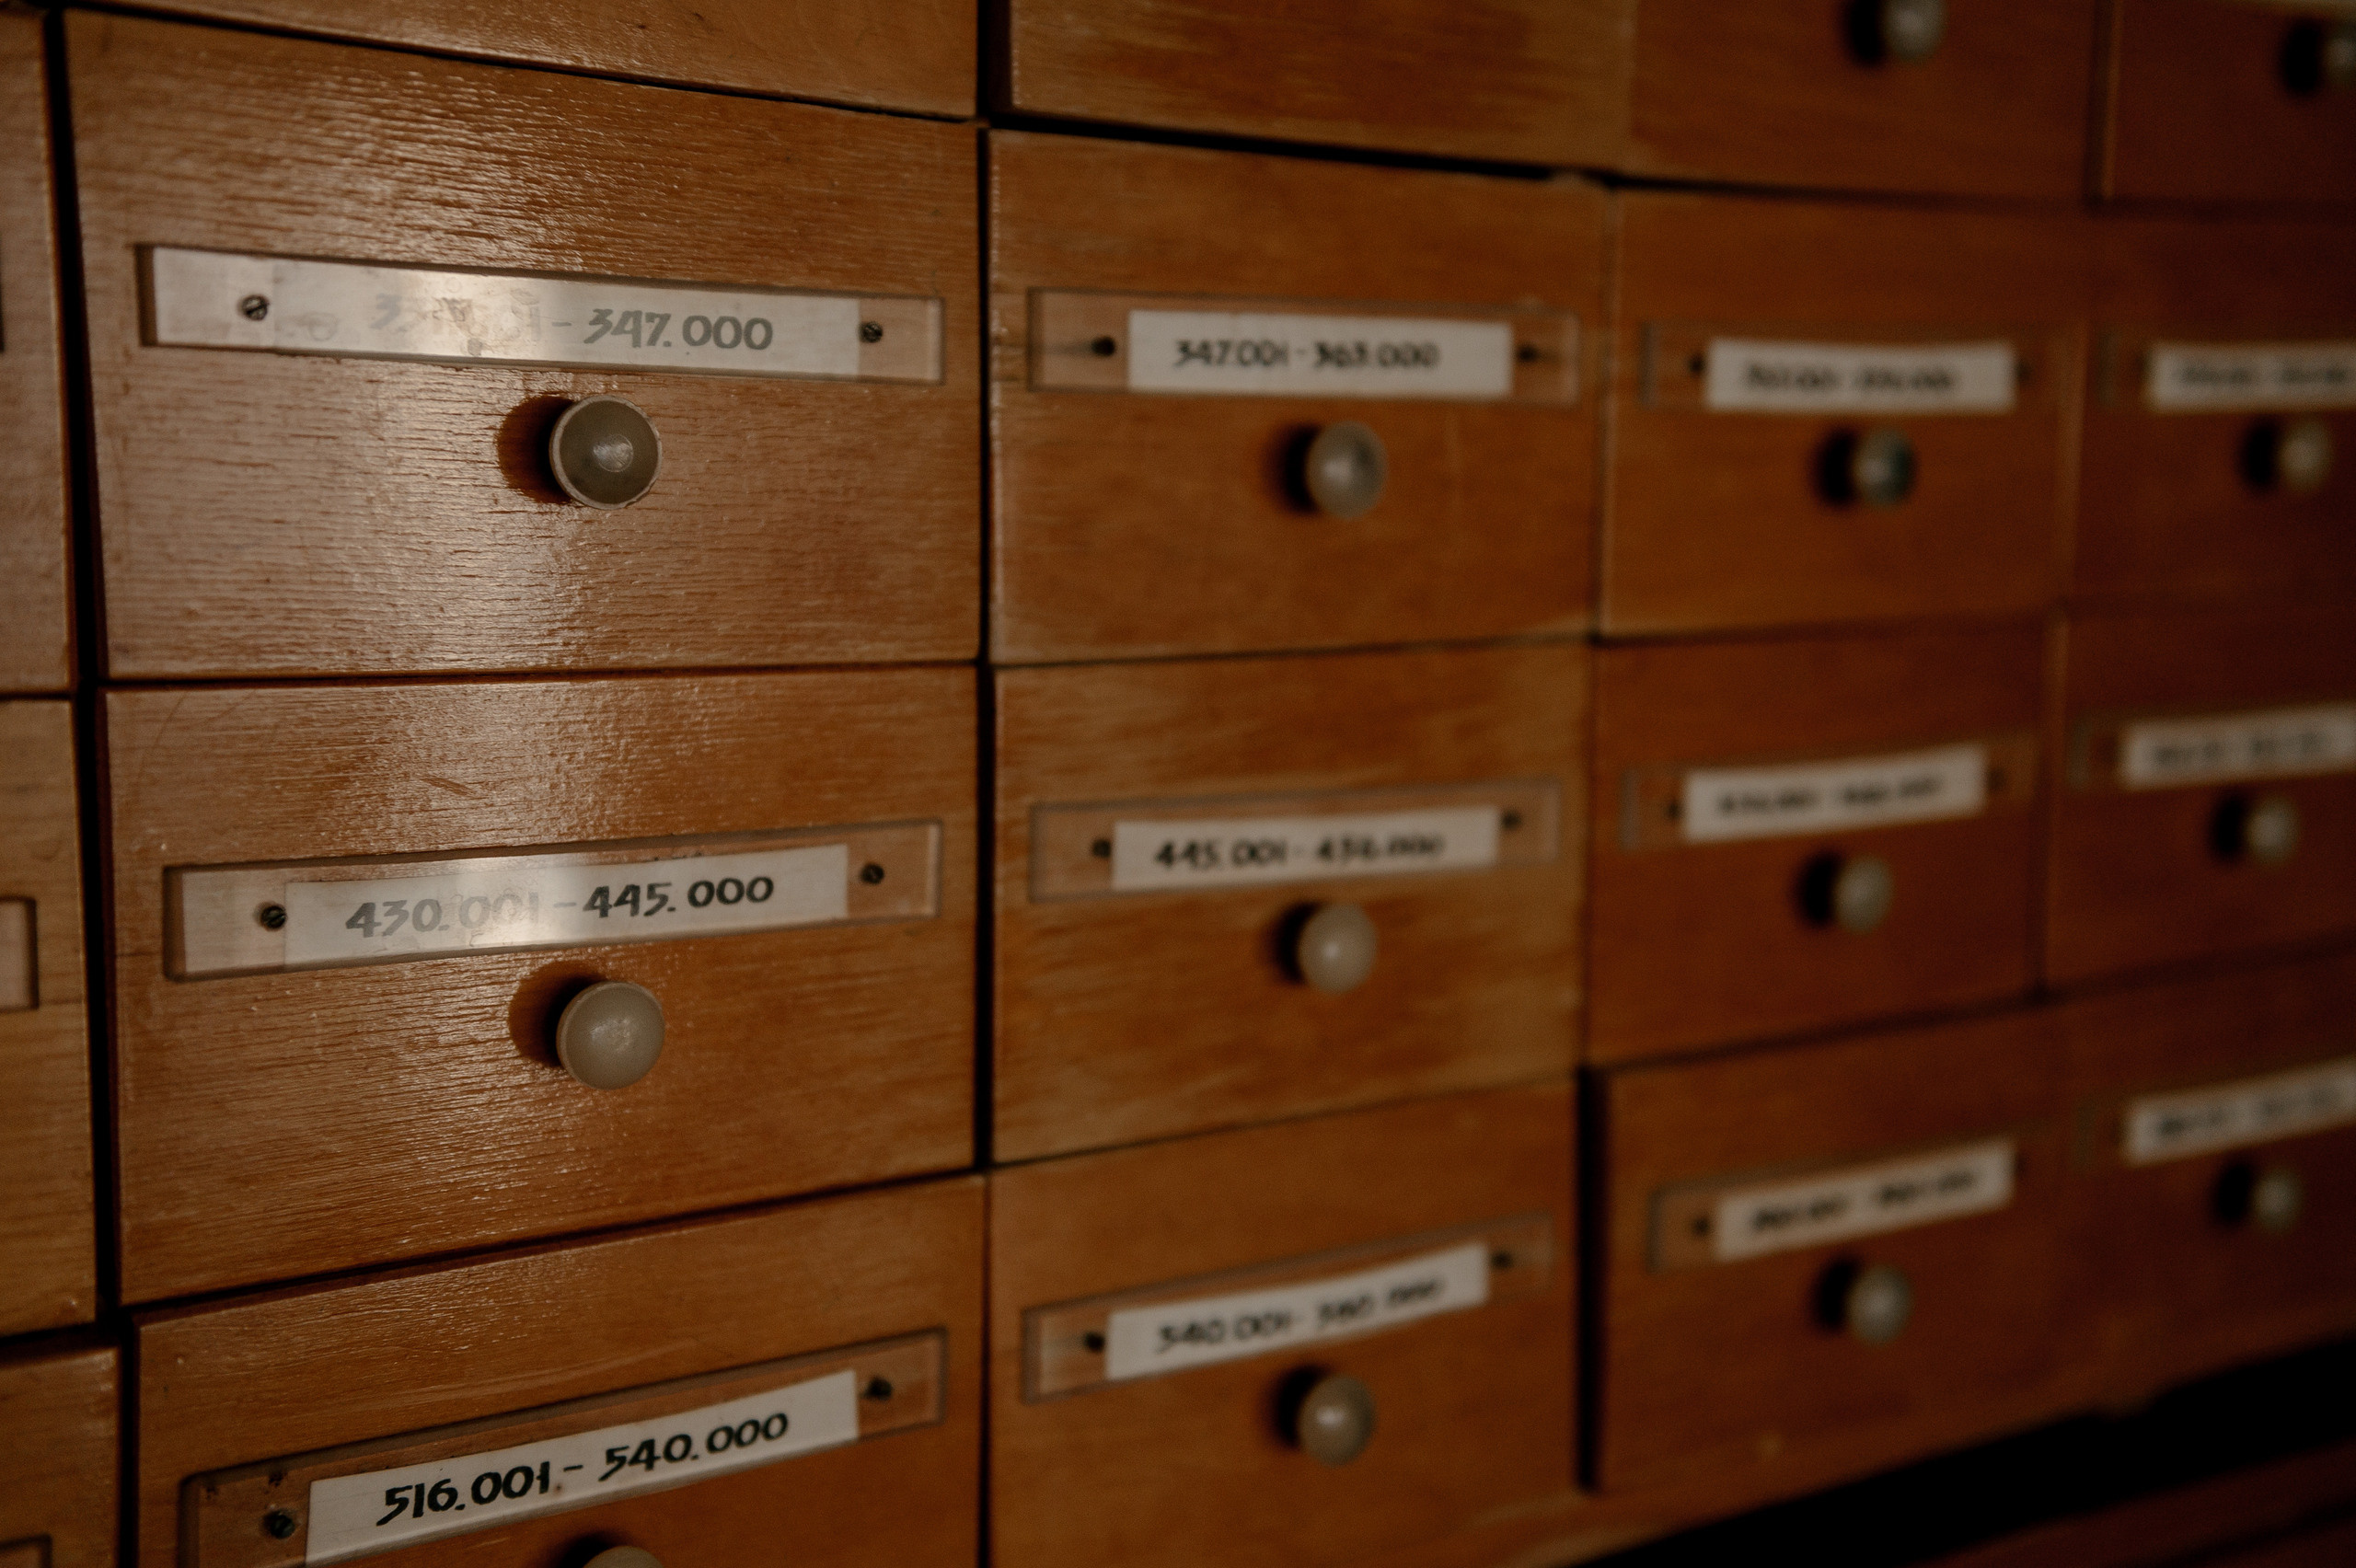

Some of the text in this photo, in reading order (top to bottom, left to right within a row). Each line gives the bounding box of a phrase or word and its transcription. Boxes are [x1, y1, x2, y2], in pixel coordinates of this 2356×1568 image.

[583, 307, 774, 351] 347.000
[345, 890, 540, 938] 430.001
[583, 876, 774, 918] 445.000
[375, 1460, 550, 1528] 516.001
[598, 1412, 789, 1482] 540.000
